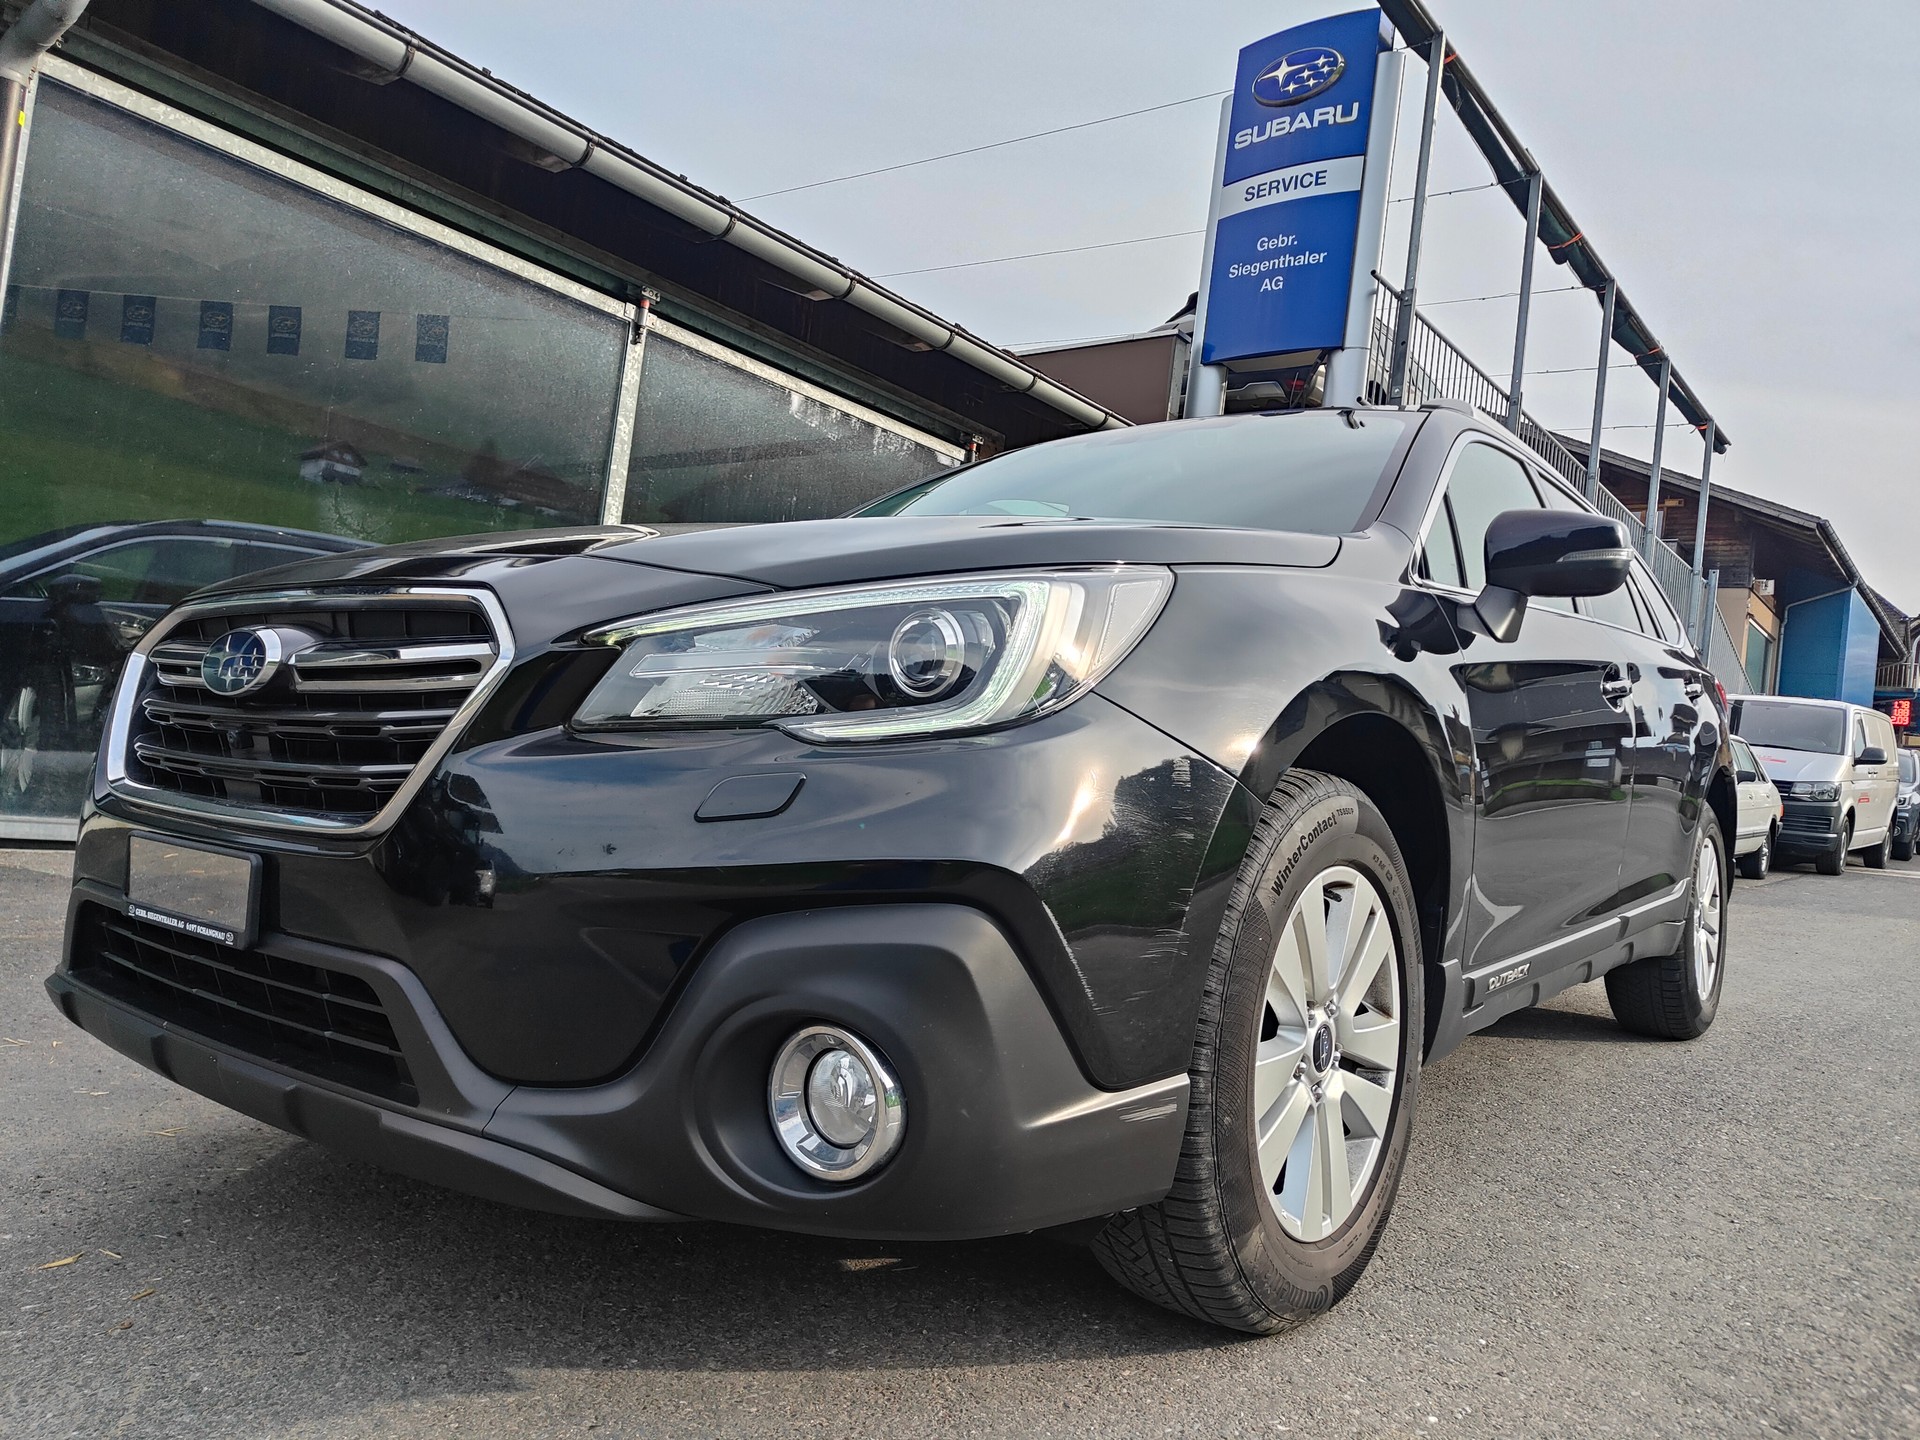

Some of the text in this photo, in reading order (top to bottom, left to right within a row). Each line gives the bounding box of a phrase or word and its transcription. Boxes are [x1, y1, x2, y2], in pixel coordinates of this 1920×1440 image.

[1234, 102, 1359, 150] SUBARU
[1244, 170, 1328, 202] SERVICE
[1256, 234, 1298, 251] Gebr.
[1228, 251, 1328, 278] Siegenthaler
[1260, 276, 1284, 293] AG
[1270, 812, 1338, 897] WinterContact
[1488, 963, 1531, 991] OUTBACK
